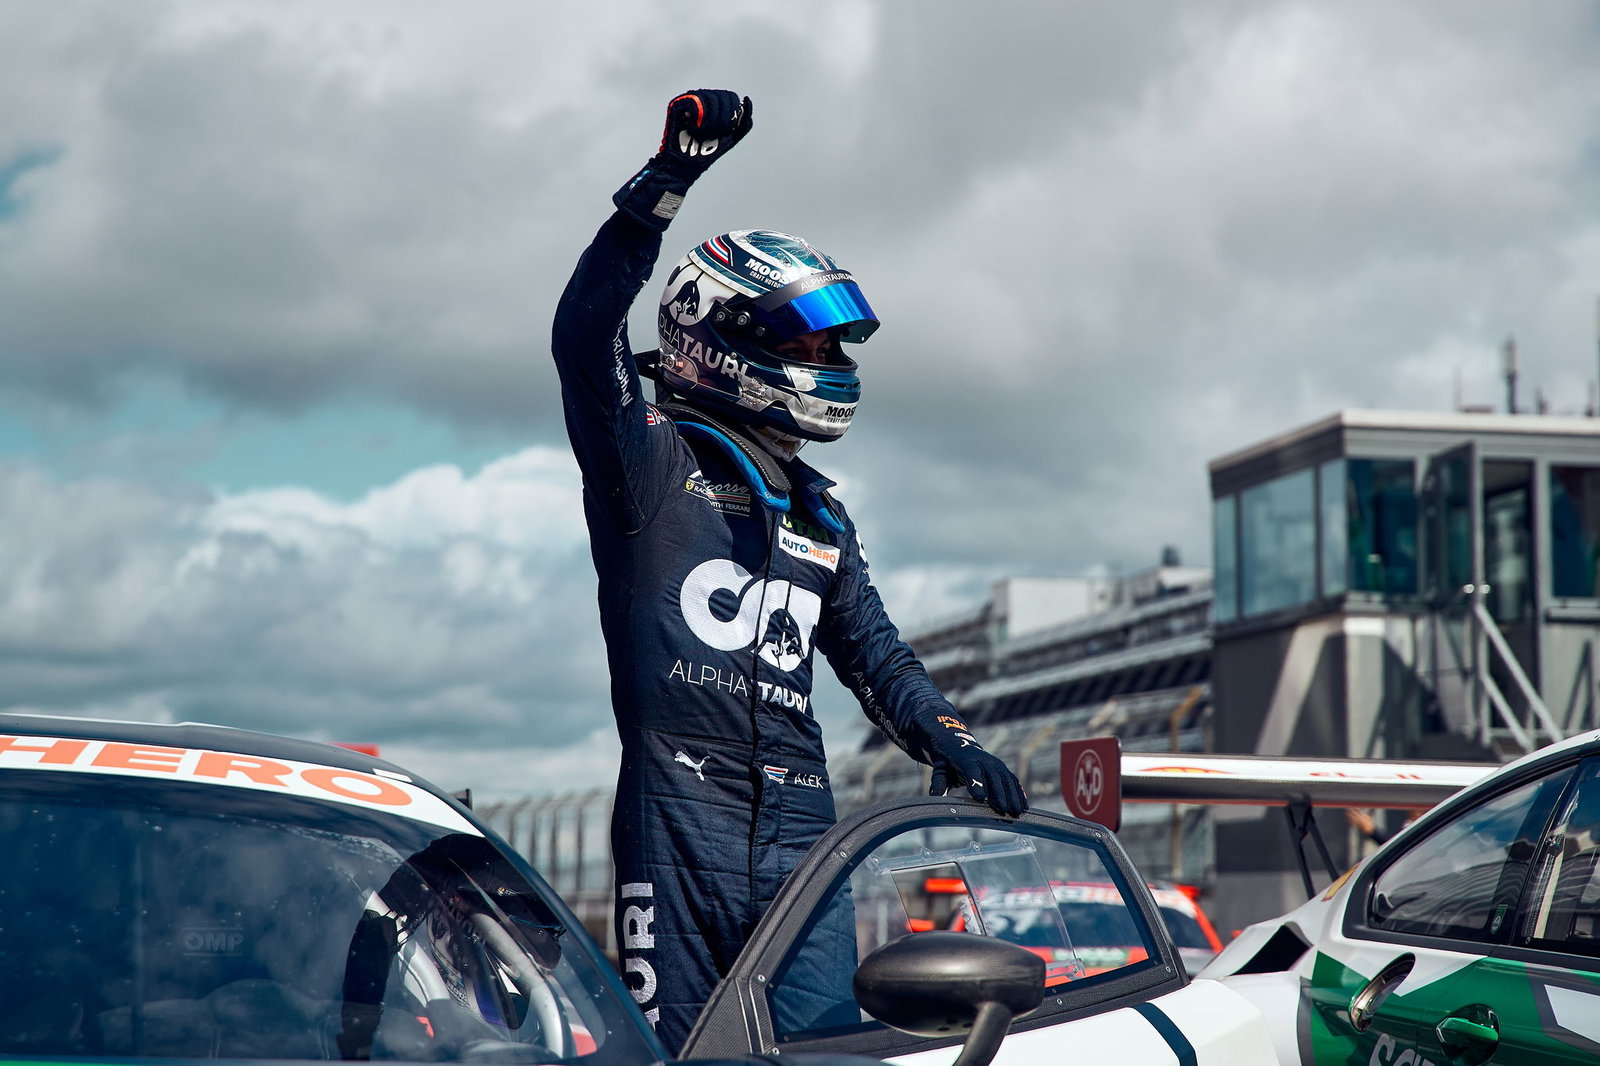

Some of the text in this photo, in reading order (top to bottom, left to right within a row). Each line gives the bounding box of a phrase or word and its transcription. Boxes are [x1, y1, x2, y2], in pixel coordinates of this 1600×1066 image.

[744, 258, 791, 285] MOOS
[825, 406, 857, 418] MOOS
[781, 536, 836, 564] AUTOHERO
[668, 659, 748, 697] ALPHA
[184, 931, 244, 952] OMP
